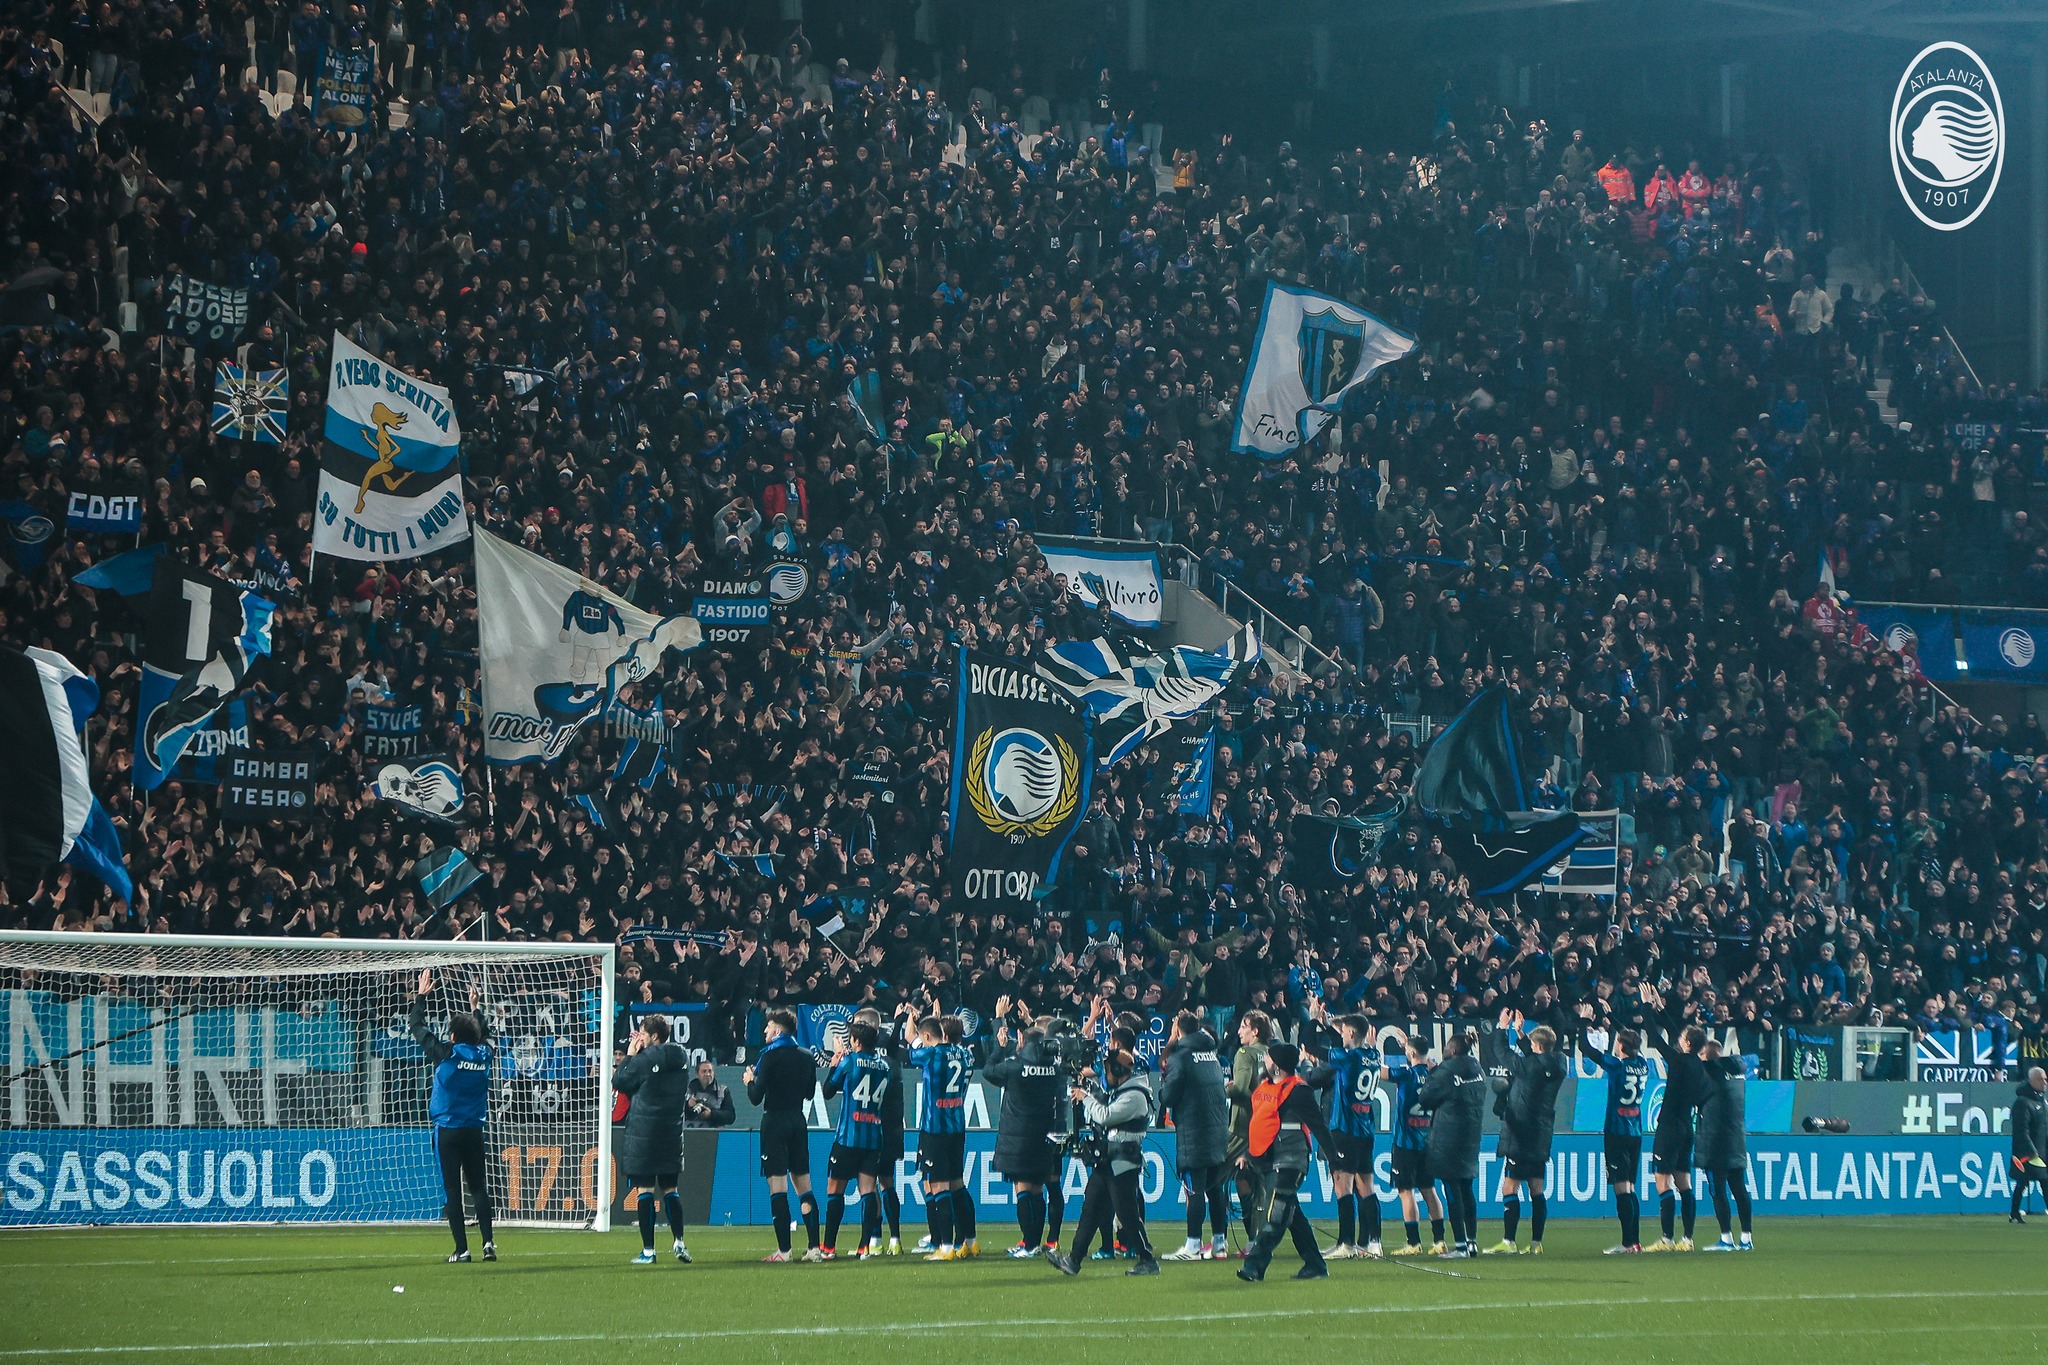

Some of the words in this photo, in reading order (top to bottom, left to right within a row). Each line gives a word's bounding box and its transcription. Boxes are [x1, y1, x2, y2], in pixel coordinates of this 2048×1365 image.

[325, 56, 369, 72] NEVER
[334, 69, 361, 83] EAT
[321, 89, 366, 104] ALONE
[166, 294, 249, 325] ADOSS
[386, 369, 450, 434] SCRITTA
[319, 491, 339, 526] SU
[342, 515, 400, 555] TUTTI
[406, 526, 417, 550] I
[417, 490, 462, 540] MURI
[697, 603, 768, 618] FASTIDIO
[708, 629, 750, 643] 1907
[366, 708, 422, 731] STUPE
[489, 714, 552, 742] mai
[364, 735, 418, 756] FATTI
[233, 759, 309, 780] GAMBA
[810, 1004, 854, 1023] COLLETTIVO
[852, 1074, 889, 1110] 44
[1354, 1069, 1380, 1102] 90
